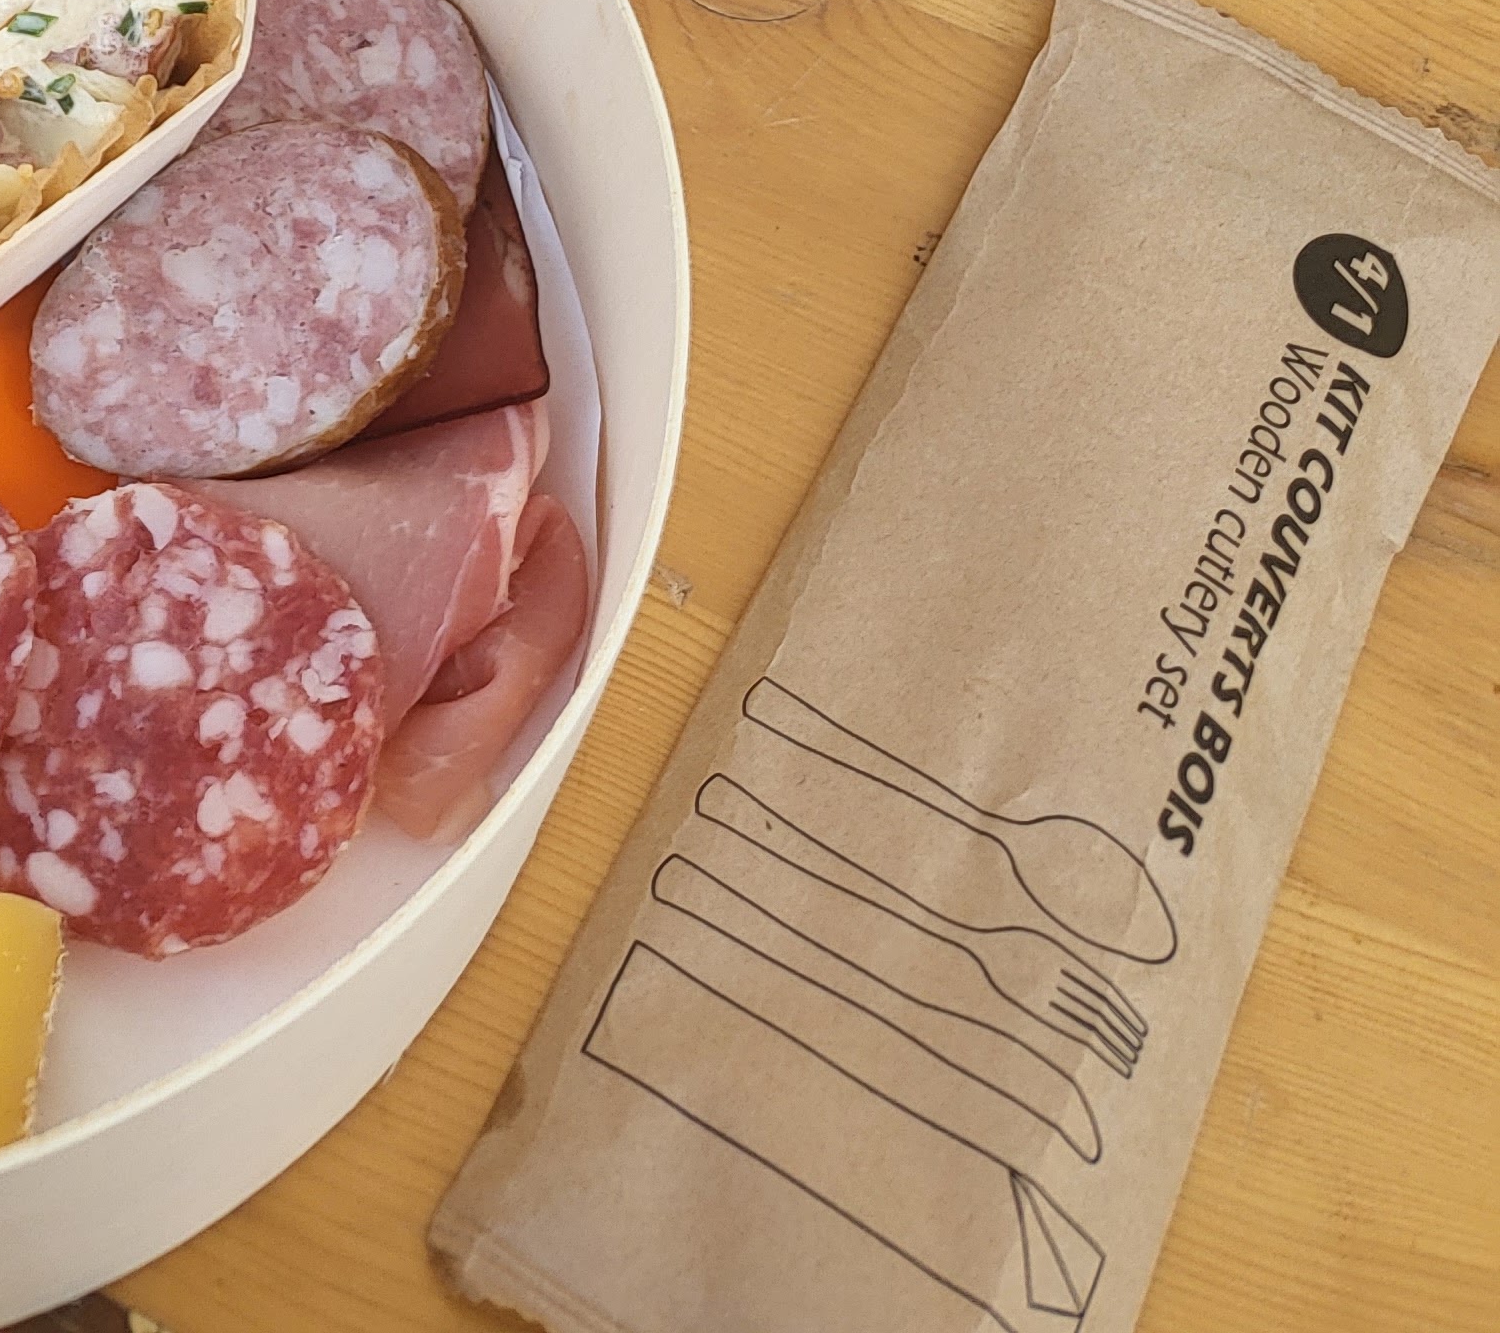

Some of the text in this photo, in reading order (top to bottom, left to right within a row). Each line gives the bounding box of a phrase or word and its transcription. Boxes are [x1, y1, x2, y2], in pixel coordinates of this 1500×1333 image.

[1137, 340, 1330, 728] Wooden cutlery set
[1156, 361, 1371, 858] KIT COUVERTS BOIS
